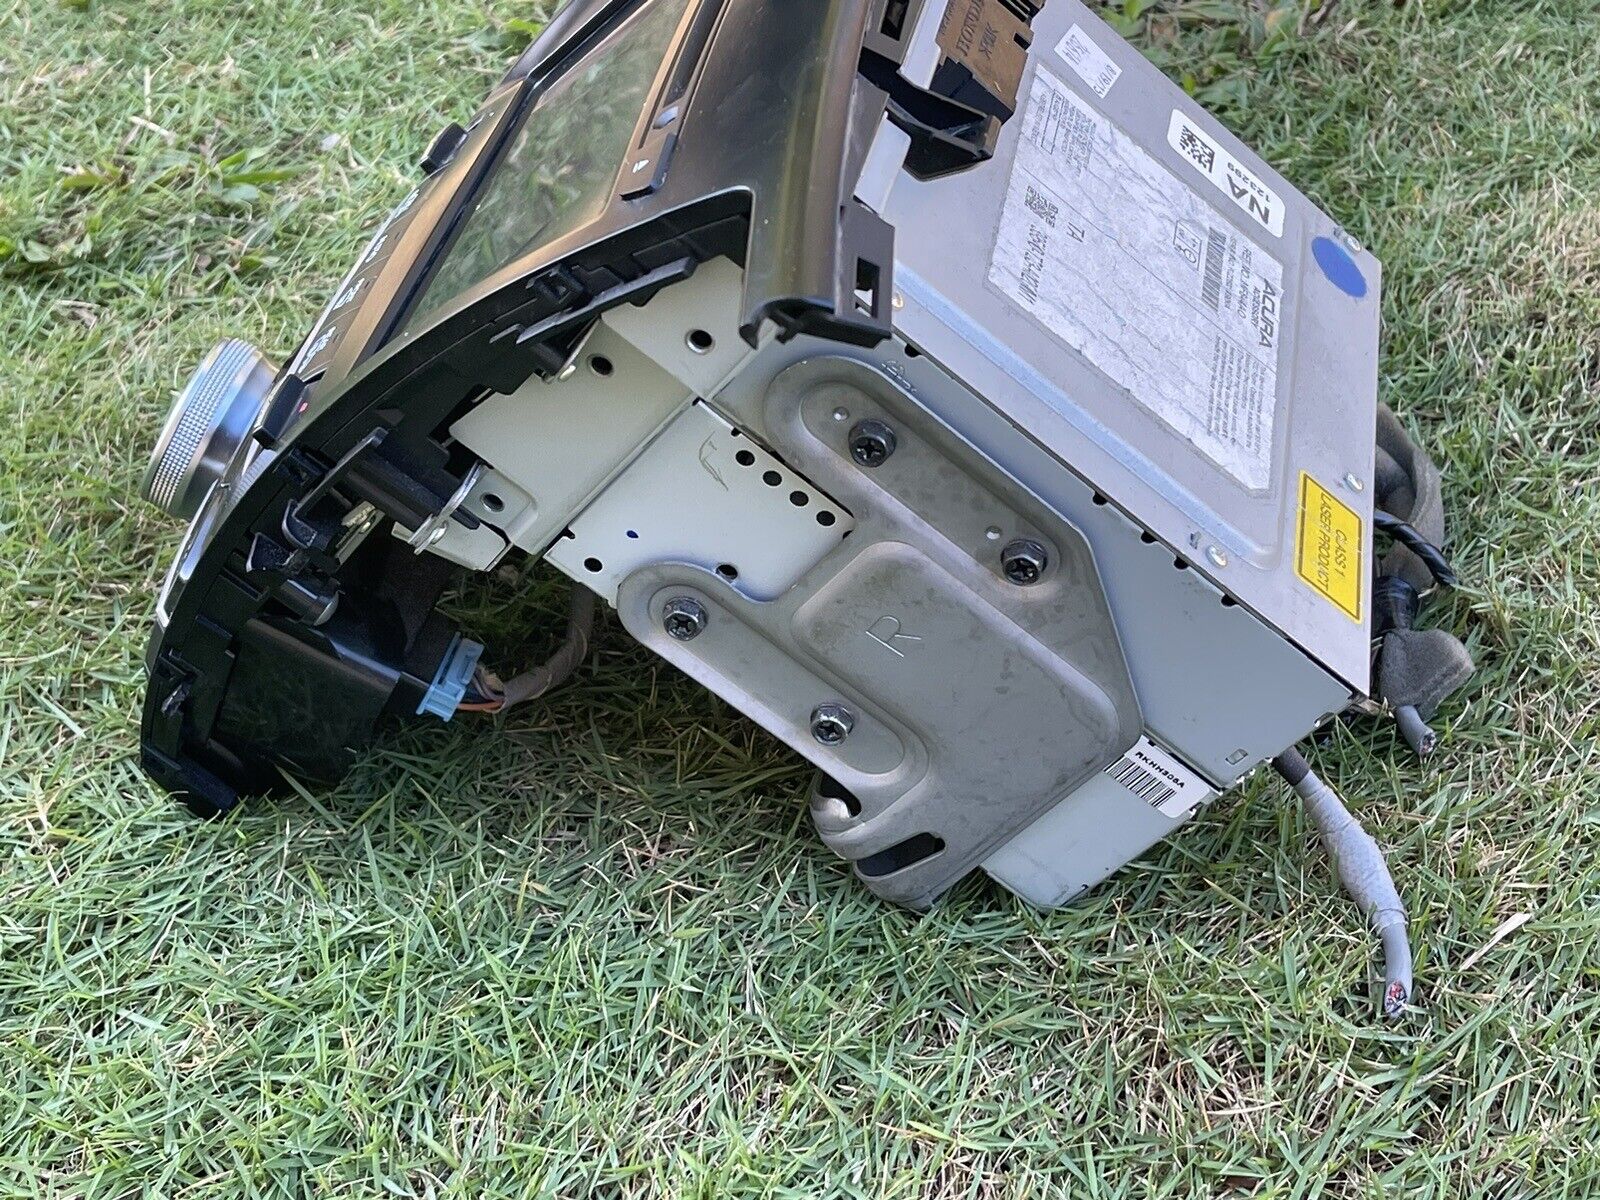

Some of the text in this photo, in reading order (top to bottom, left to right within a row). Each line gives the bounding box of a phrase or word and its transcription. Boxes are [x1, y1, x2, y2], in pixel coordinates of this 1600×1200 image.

[1227, 174, 1270, 225] NA
[1228, 162, 1271, 202] 123299
[1066, 221, 1085, 244] TA
[1259, 278, 1276, 348] ACURA
[865, 614, 922, 658] R
